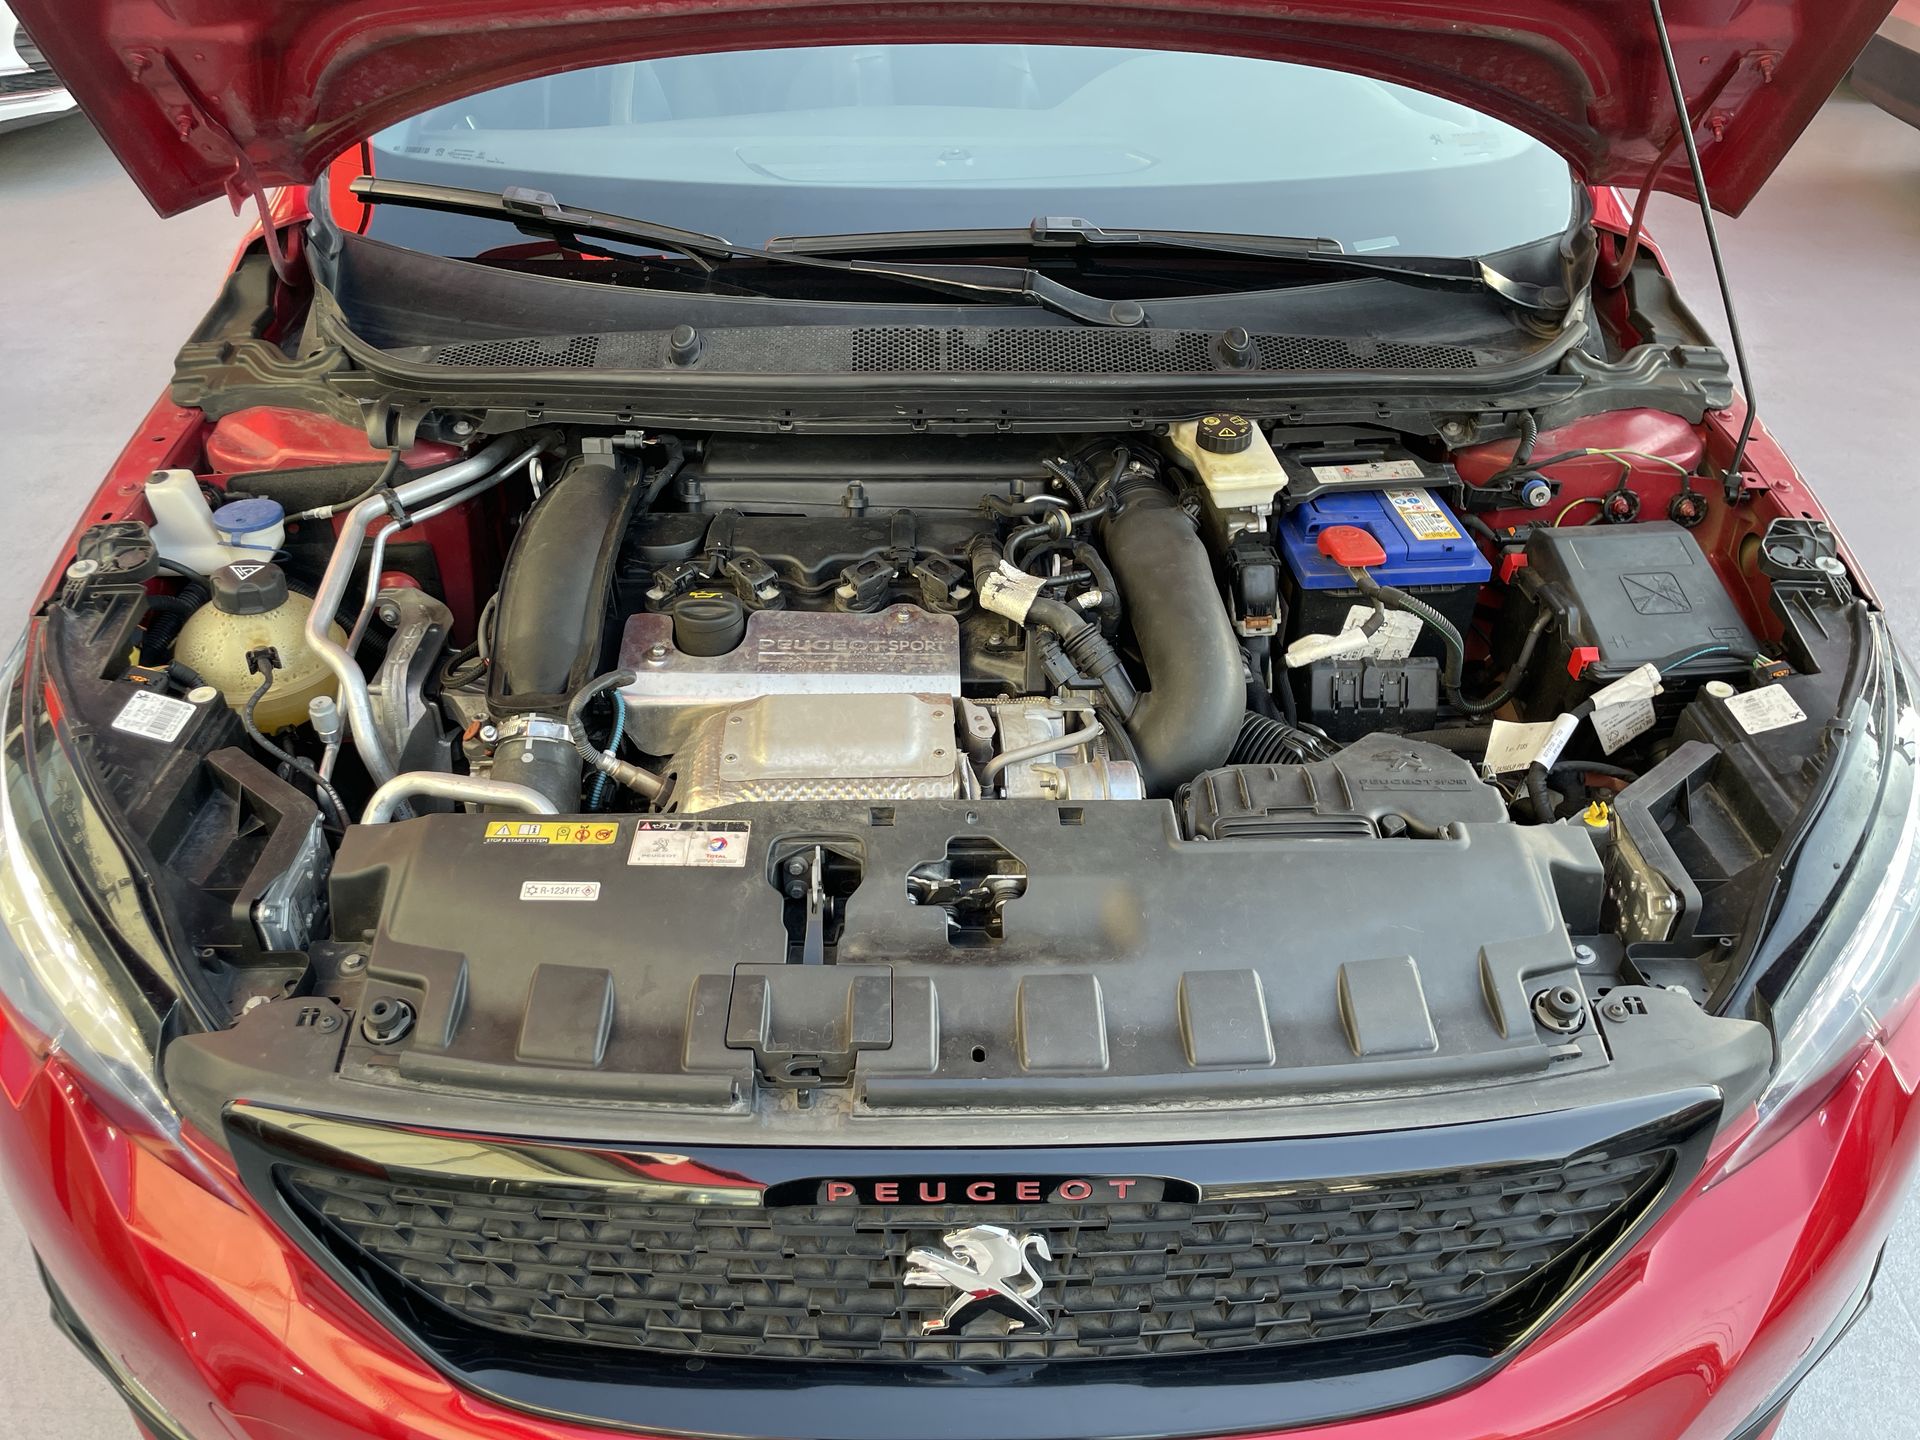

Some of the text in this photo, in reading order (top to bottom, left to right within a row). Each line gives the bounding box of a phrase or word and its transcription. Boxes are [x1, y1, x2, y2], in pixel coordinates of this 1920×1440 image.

[888, 640, 948, 651] SPORT
[540, 886, 581, 895] R-1234YF
[827, 1179, 1137, 1202] PEUGEOT
